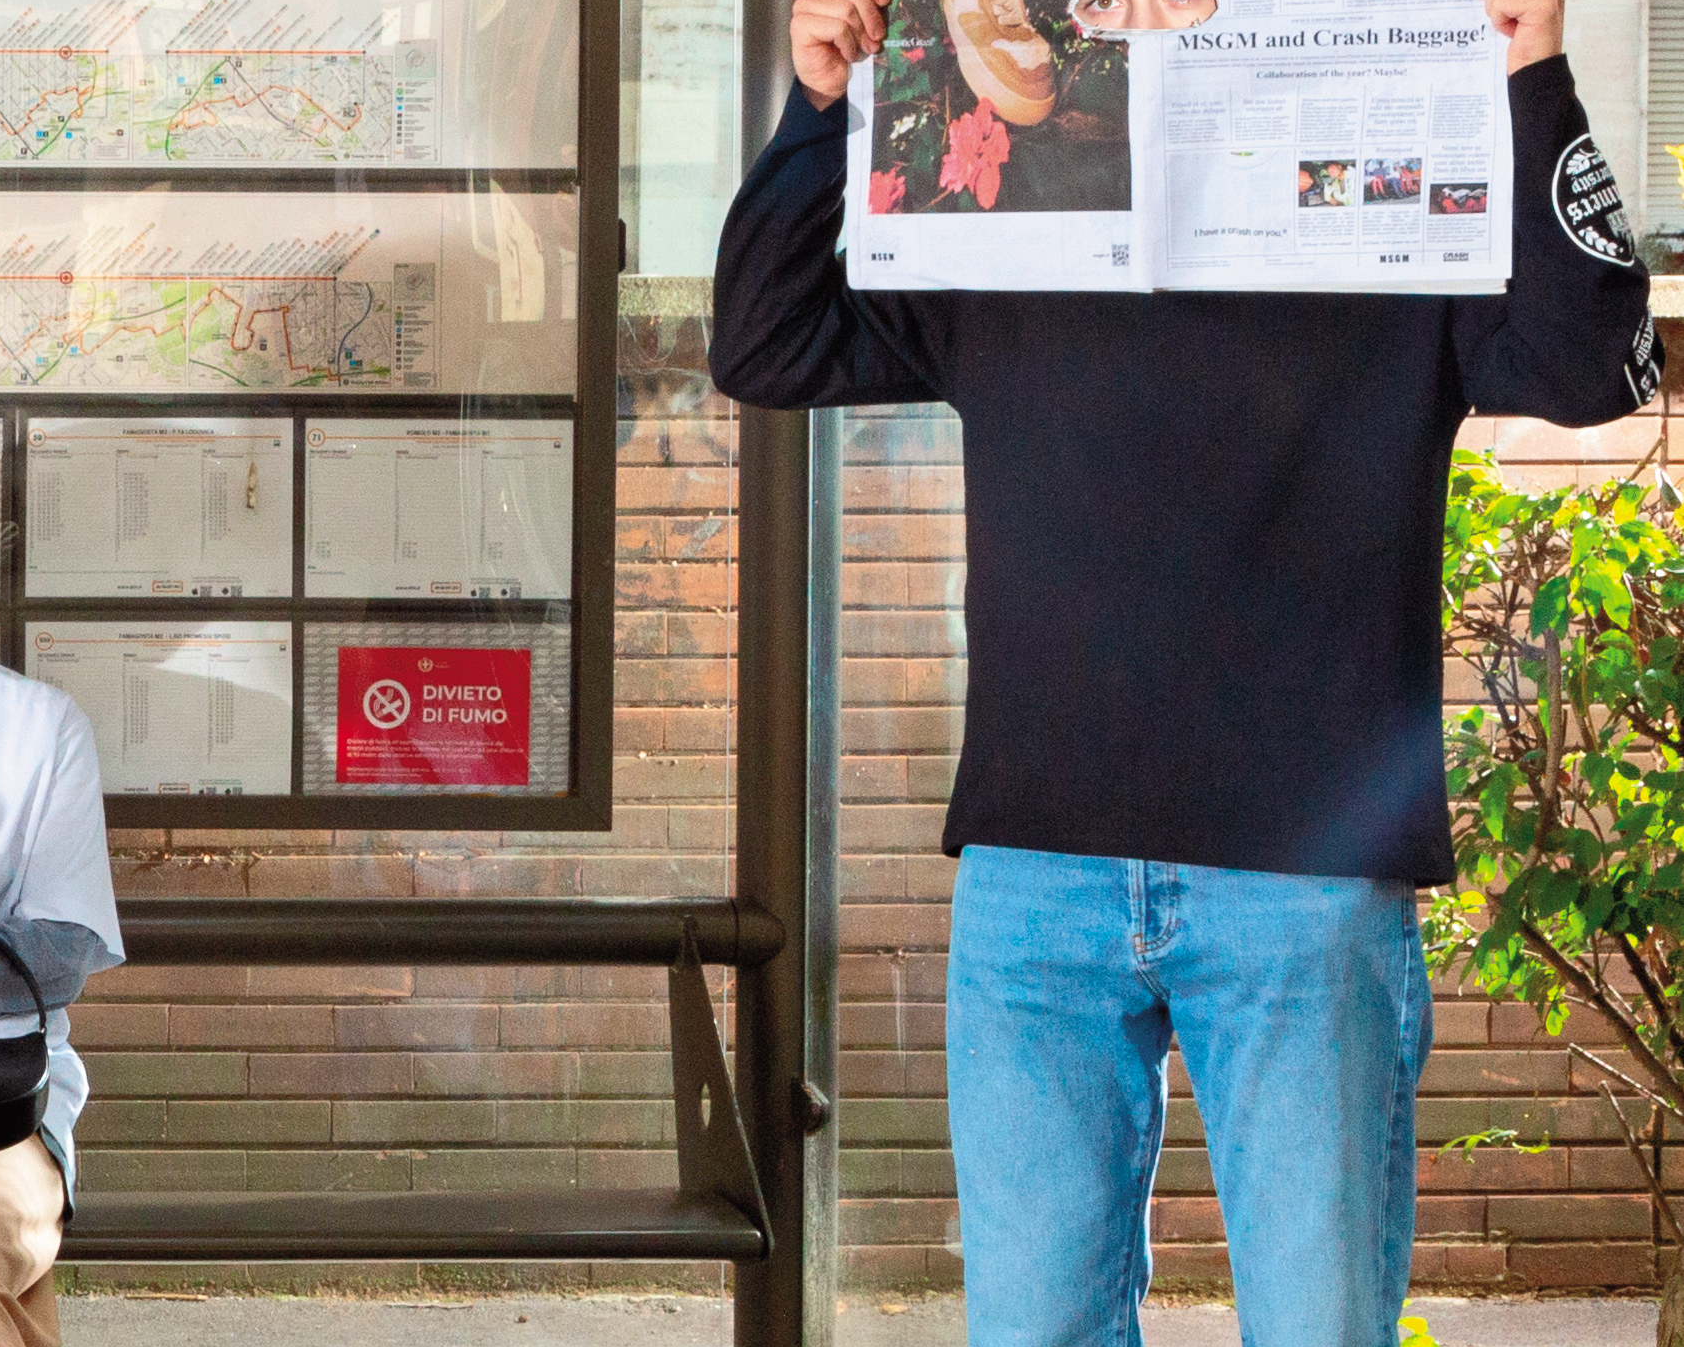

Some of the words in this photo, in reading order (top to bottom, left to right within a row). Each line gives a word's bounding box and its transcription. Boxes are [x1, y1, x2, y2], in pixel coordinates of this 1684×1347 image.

[1177, 32, 1258, 51] MSGM
[1265, 30, 1306, 48] and
[1313, 27, 1379, 47] Crash
[1388, 24, 1487, 48] Baggage!
[1379, 255, 1409, 263] MSGM
[423, 685, 502, 701] DIVIETO
[423, 708, 442, 723] DI
[448, 708, 507, 724] FUMO
